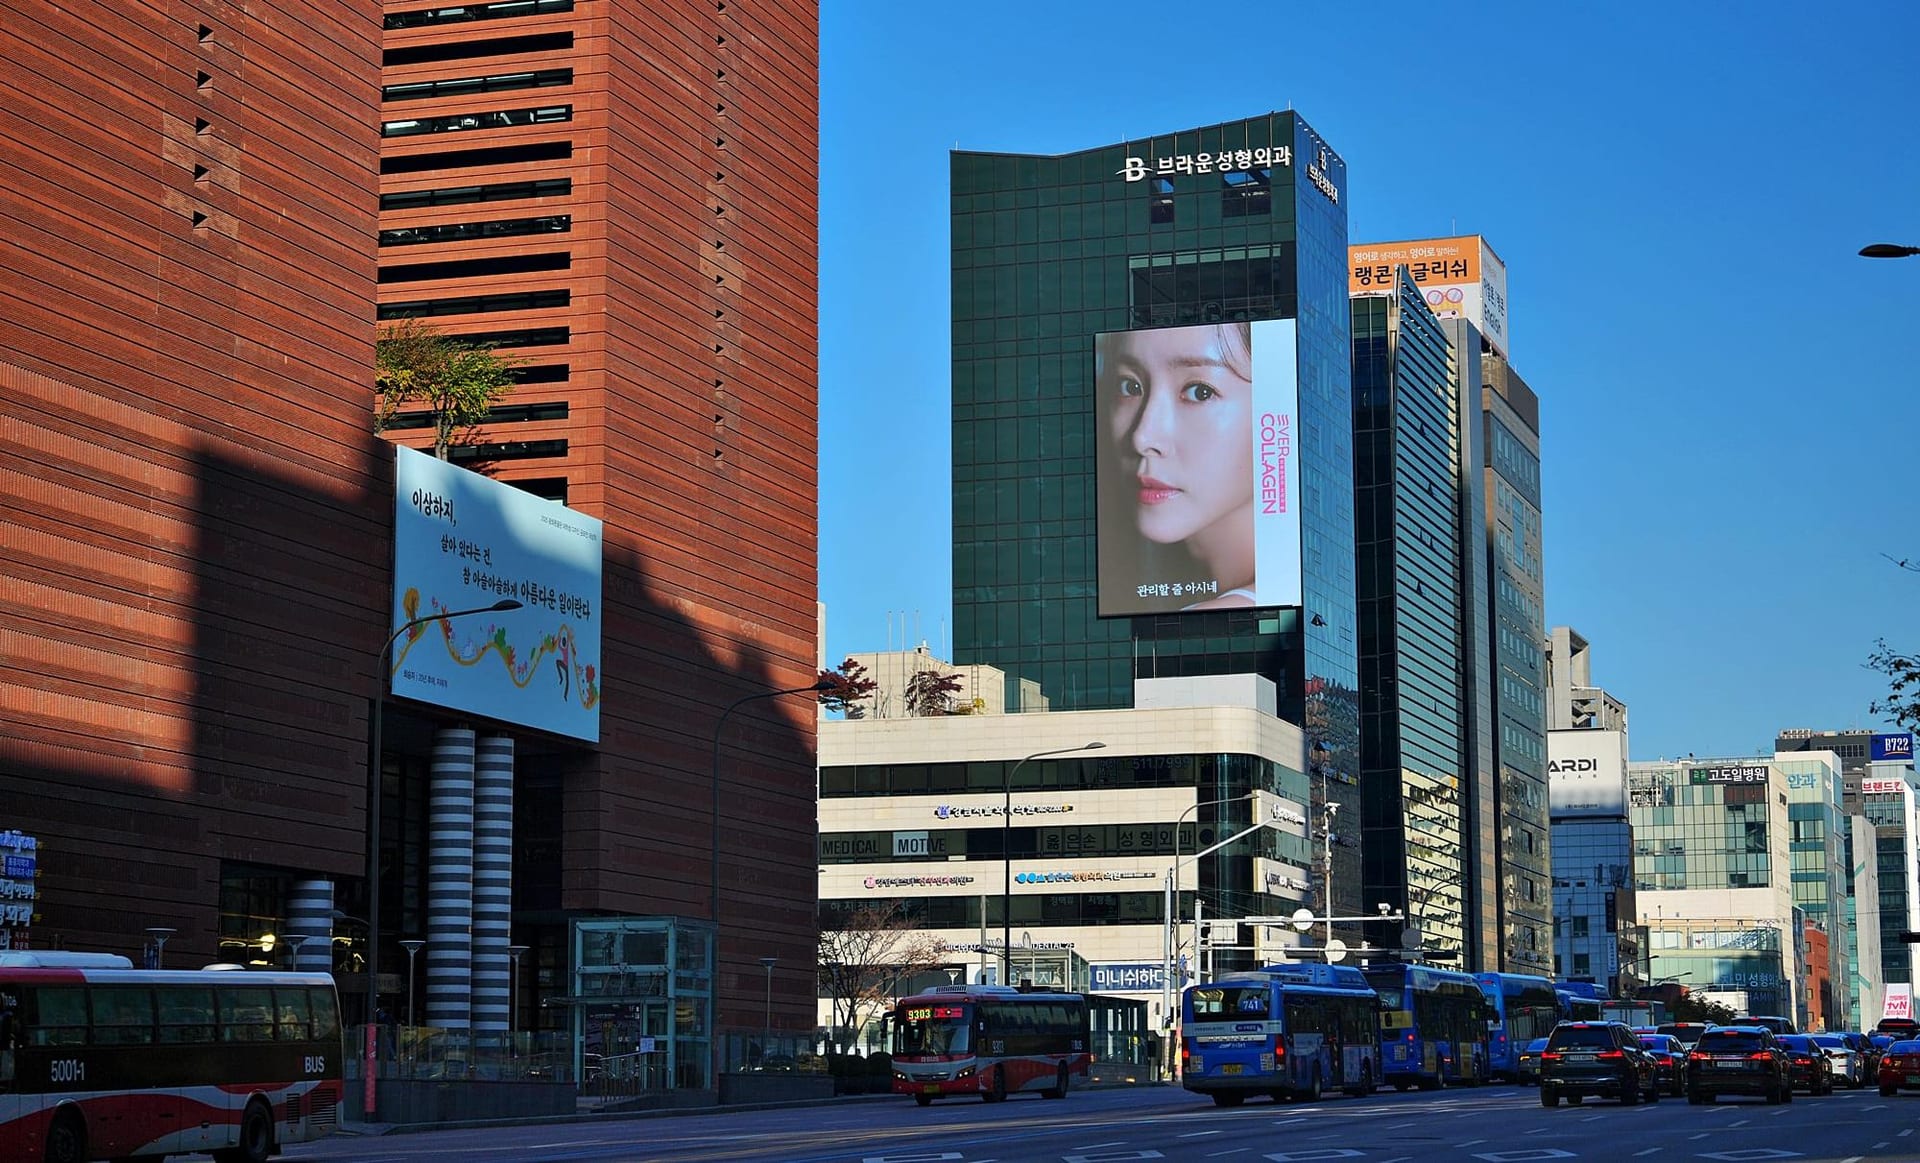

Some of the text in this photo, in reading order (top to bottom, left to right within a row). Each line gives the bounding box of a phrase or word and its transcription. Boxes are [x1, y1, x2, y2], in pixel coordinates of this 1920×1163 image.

[1156, 146, 1292, 176] 브라운 성형외과
[1354, 251, 1379, 263] 영어로
[1410, 247, 1436, 259] 영어로
[1355, 259, 1468, 286] 랭콘글리쉬
[1278, 414, 1290, 457] EVER
[1260, 413, 1277, 514] COLLAGEN
[412, 488, 457, 527] 이상하지,
[441, 533, 457, 555] 살아
[458, 540, 482, 562] 있다는
[463, 567, 592, 620] 참 아슬아슬하게 아름다운 일이란다
[1136, 580, 1217, 598] 관리할 줄 아시네
[1708, 766, 1765, 782] 고도일병원
[1787, 773, 1816, 790] 안과
[822, 837, 946, 856] MEDICAL MOTIVE
[1120, 829, 1193, 847] 성형외과
[1243, 1000, 1258, 1010] 741
[1887, 1001, 1907, 1010] tvN
[907, 1009, 932, 1020] 9303
[51, 1059, 85, 1082] 5001-1
[304, 1056, 325, 1074] BUS
